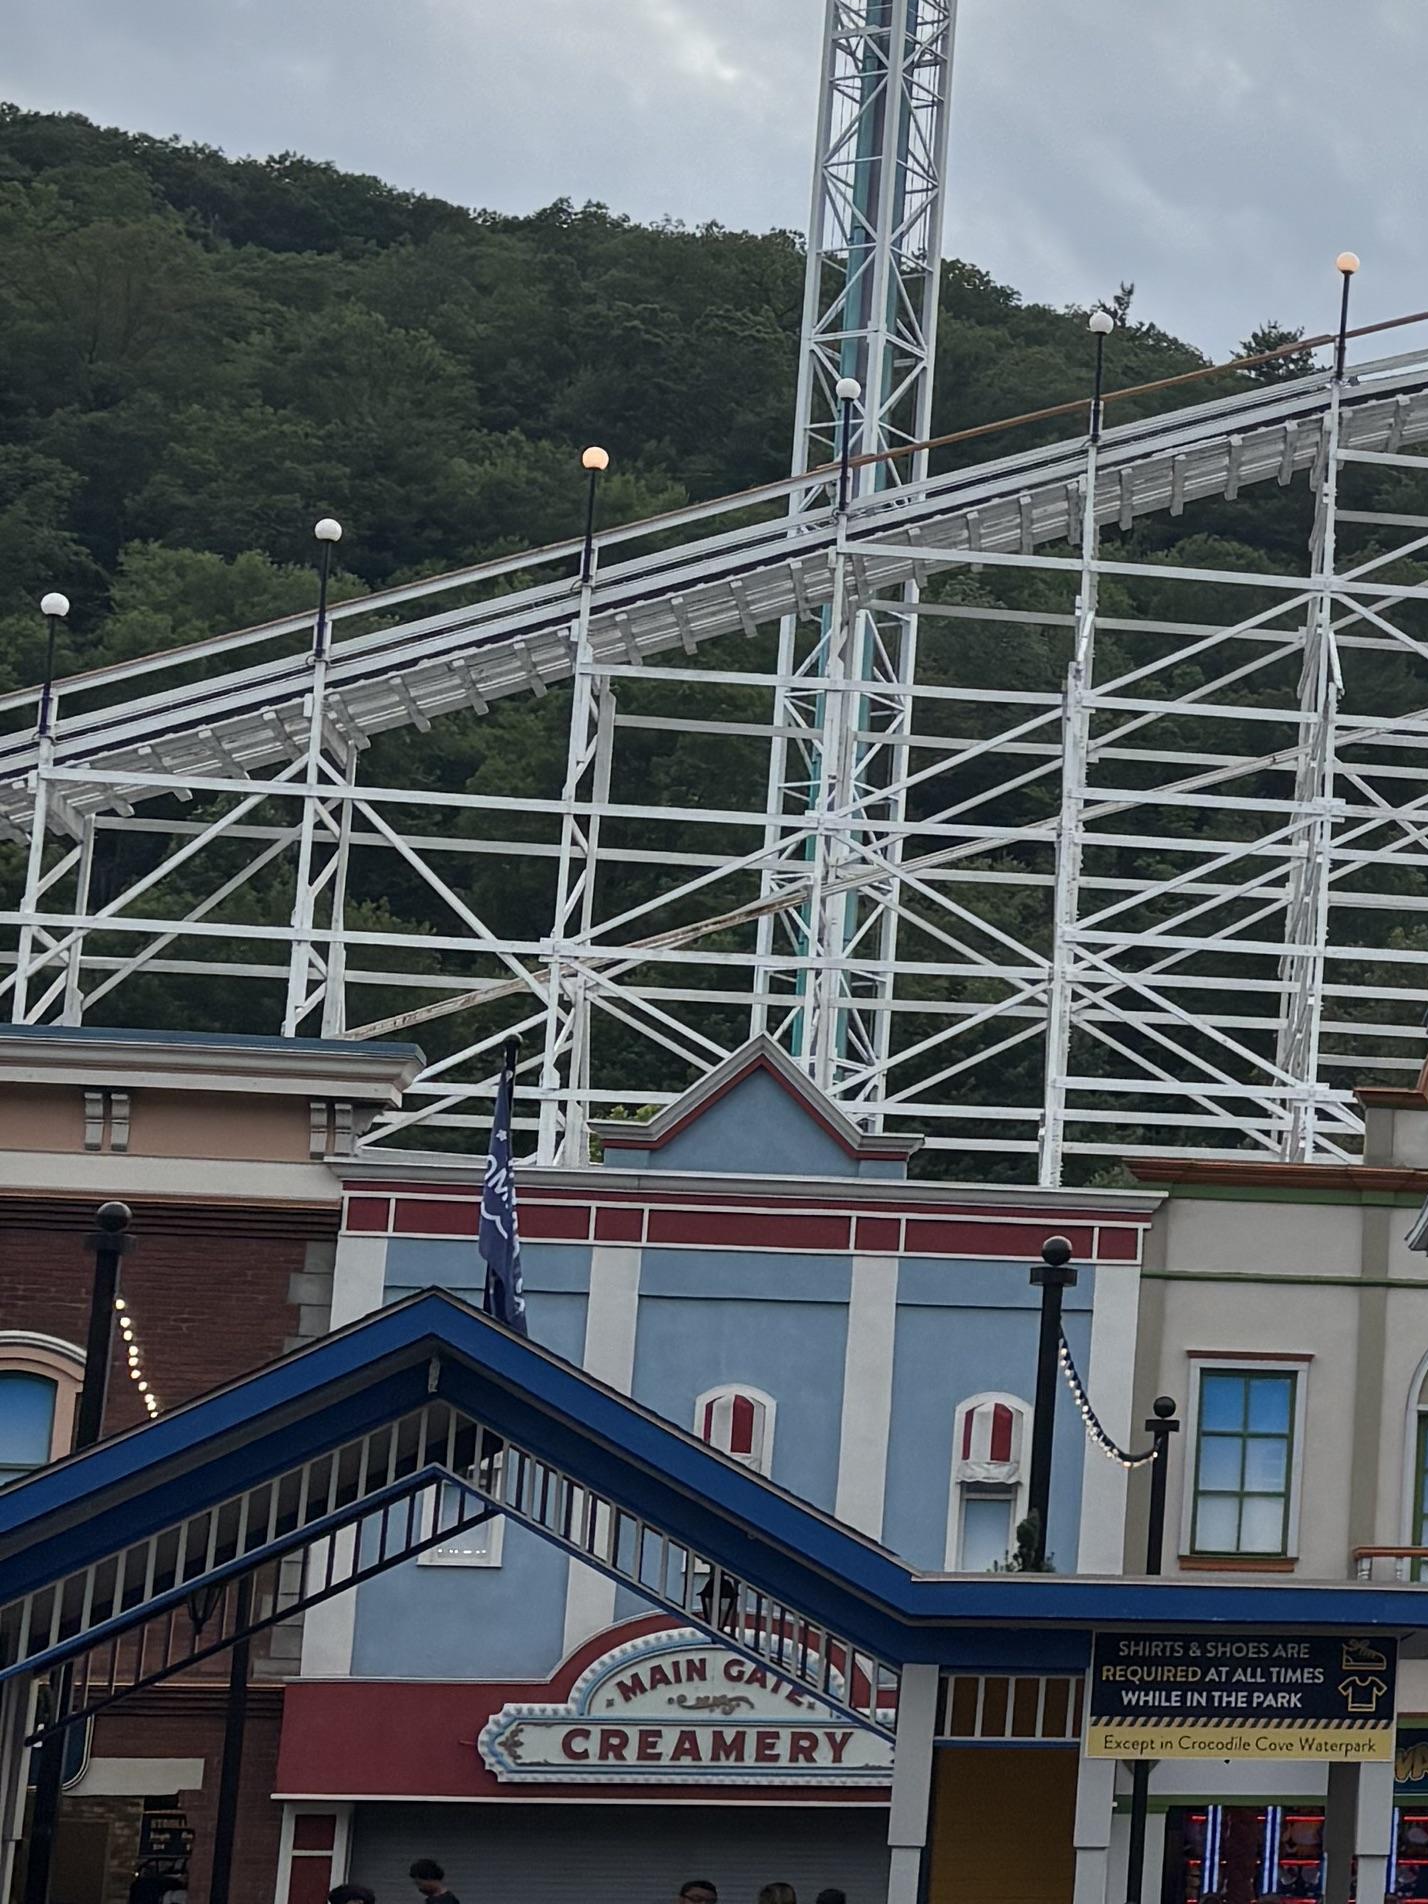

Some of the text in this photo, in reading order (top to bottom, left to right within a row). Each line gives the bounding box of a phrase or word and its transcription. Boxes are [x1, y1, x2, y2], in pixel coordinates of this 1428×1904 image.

[1118, 1641, 1310, 1659] SHIRTS & SHOES ARE
[614, 1657, 708, 1703] MAIN
[1101, 1666, 1325, 1684] REQUIRED AT ALL TIMES
[1120, 1690, 1303, 1709] WHILE IN THE PARK
[561, 1729, 855, 1765] CREAMERY
[1103, 1734, 1376, 1757] Except in Crocodile Cove Waterpark
